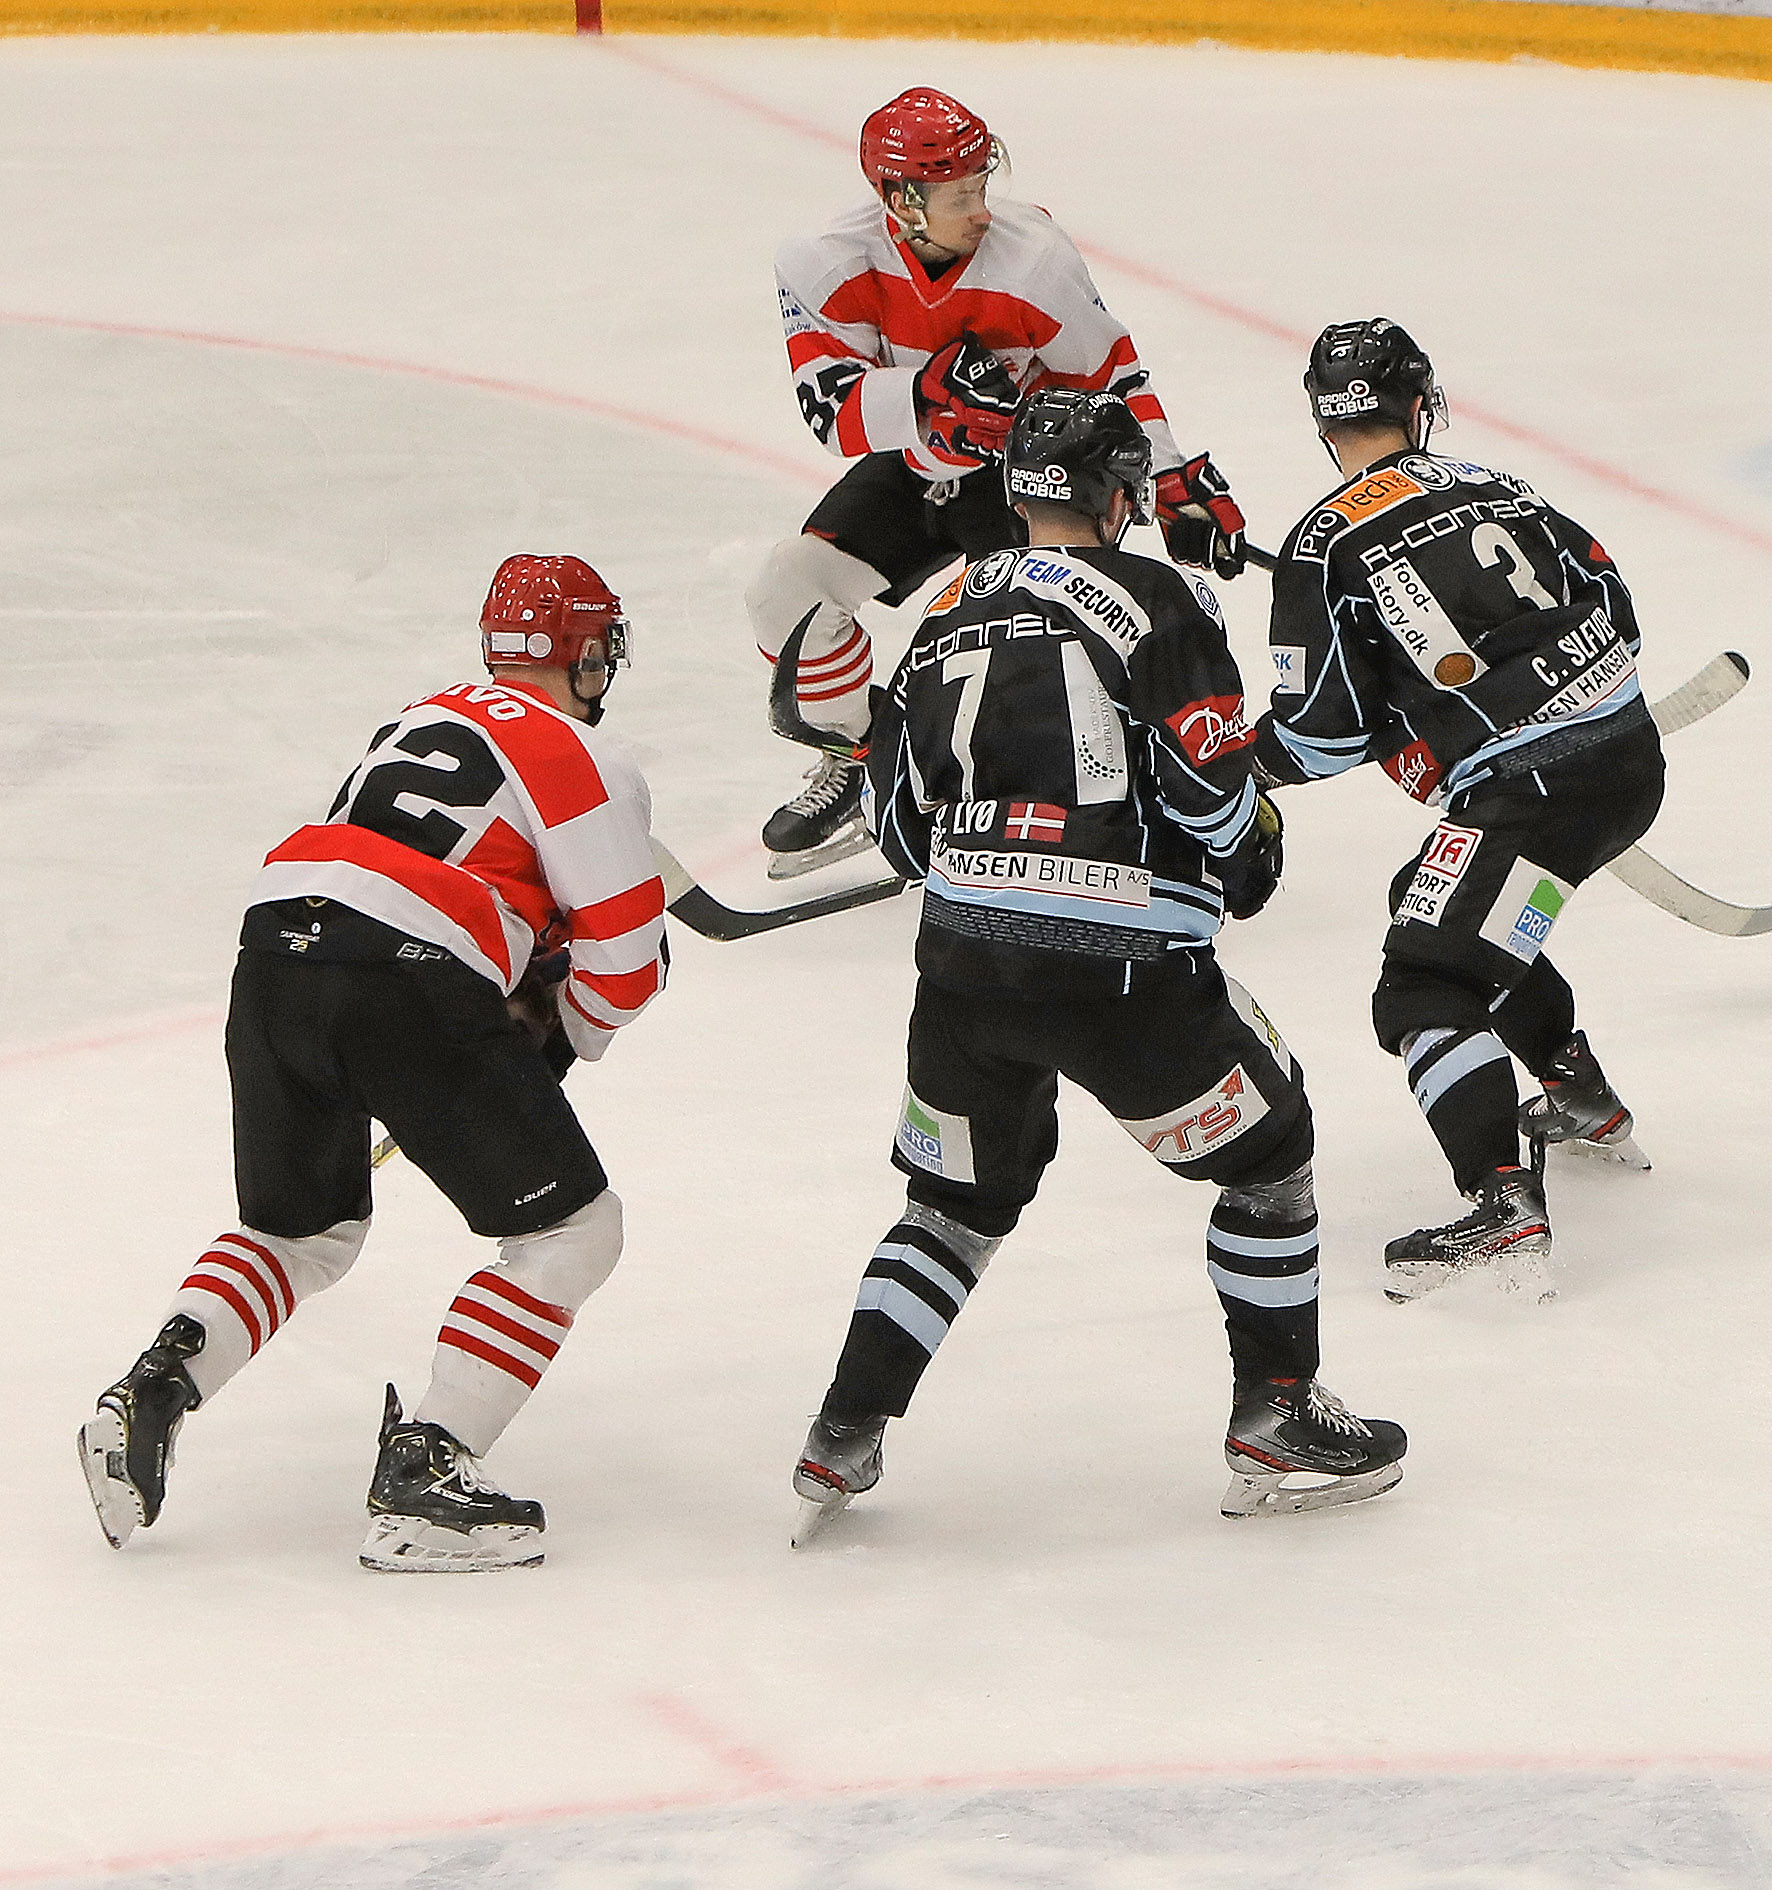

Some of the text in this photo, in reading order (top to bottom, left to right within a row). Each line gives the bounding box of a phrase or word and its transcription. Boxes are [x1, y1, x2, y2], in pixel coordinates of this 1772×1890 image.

[1318, 392, 1350, 405] RADIO
[1320, 395, 1379, 418] GLOBUS
[1043, 420, 1055, 434] 7
[1011, 468, 1045, 484] RADIO
[1011, 481, 1072, 500] GLOBUS
[1299, 510, 1338, 554] Pro
[1339, 478, 1399, 511] Tech
[1471, 522, 1560, 610] 3
[1020, 558, 1142, 644] TEAM SECURITY
[1392, 560, 1432, 613] food-
[1372, 574, 1431, 657] story.dk
[1530, 655, 1570, 688] C.
[942, 646, 994, 800] 7
[952, 799, 998, 835] LYØ
[1038, 857, 1120, 890] BILER
[1127, 870, 1150, 886] A/S
[1518, 909, 1550, 940] PRO
[903, 1126, 941, 1154] PRO
